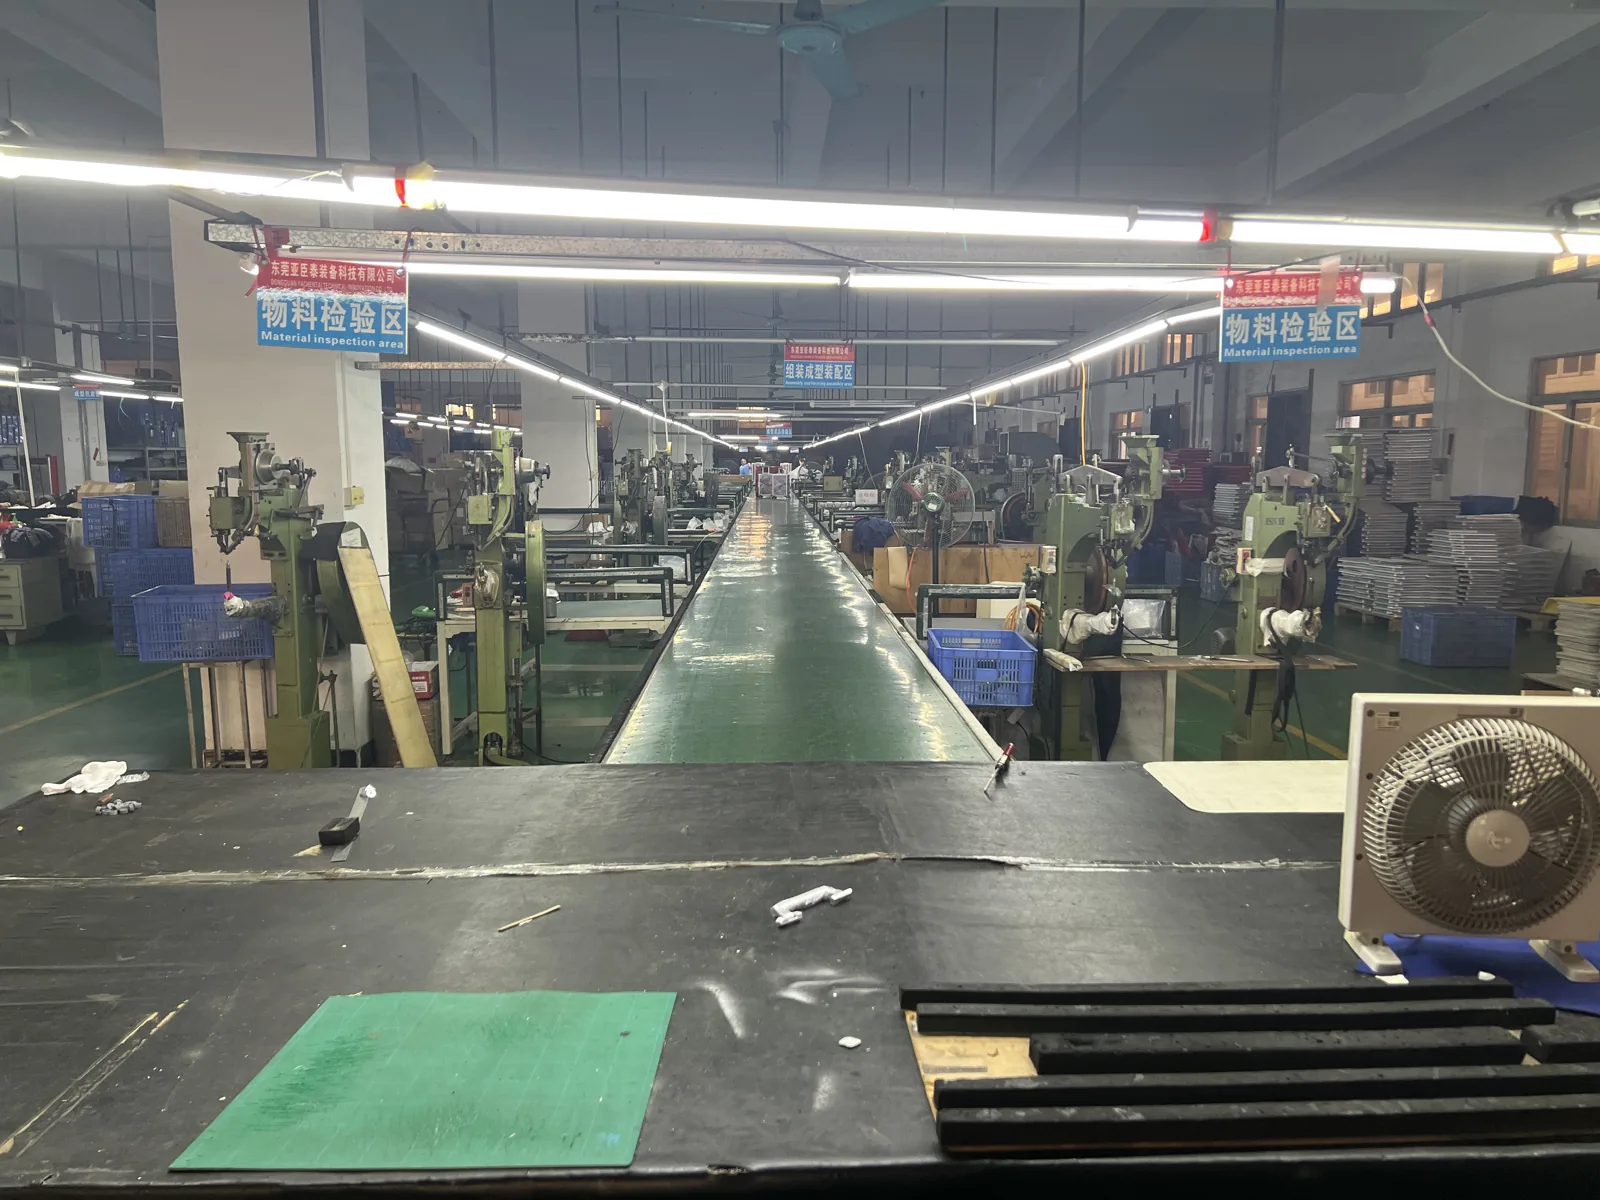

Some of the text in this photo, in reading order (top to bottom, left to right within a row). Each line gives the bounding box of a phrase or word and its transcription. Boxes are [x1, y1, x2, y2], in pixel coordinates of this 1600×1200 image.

[271, 260, 395, 283] 东莞亚臣泰装备科技有限公司
[261, 297, 404, 335] 物料检验区
[1225, 311, 1358, 345] 物料检验区
[261, 331, 404, 349] Material inspection area
[1224, 344, 1357, 357] Material inspection area
[785, 363, 853, 380] 组装成型装配区
